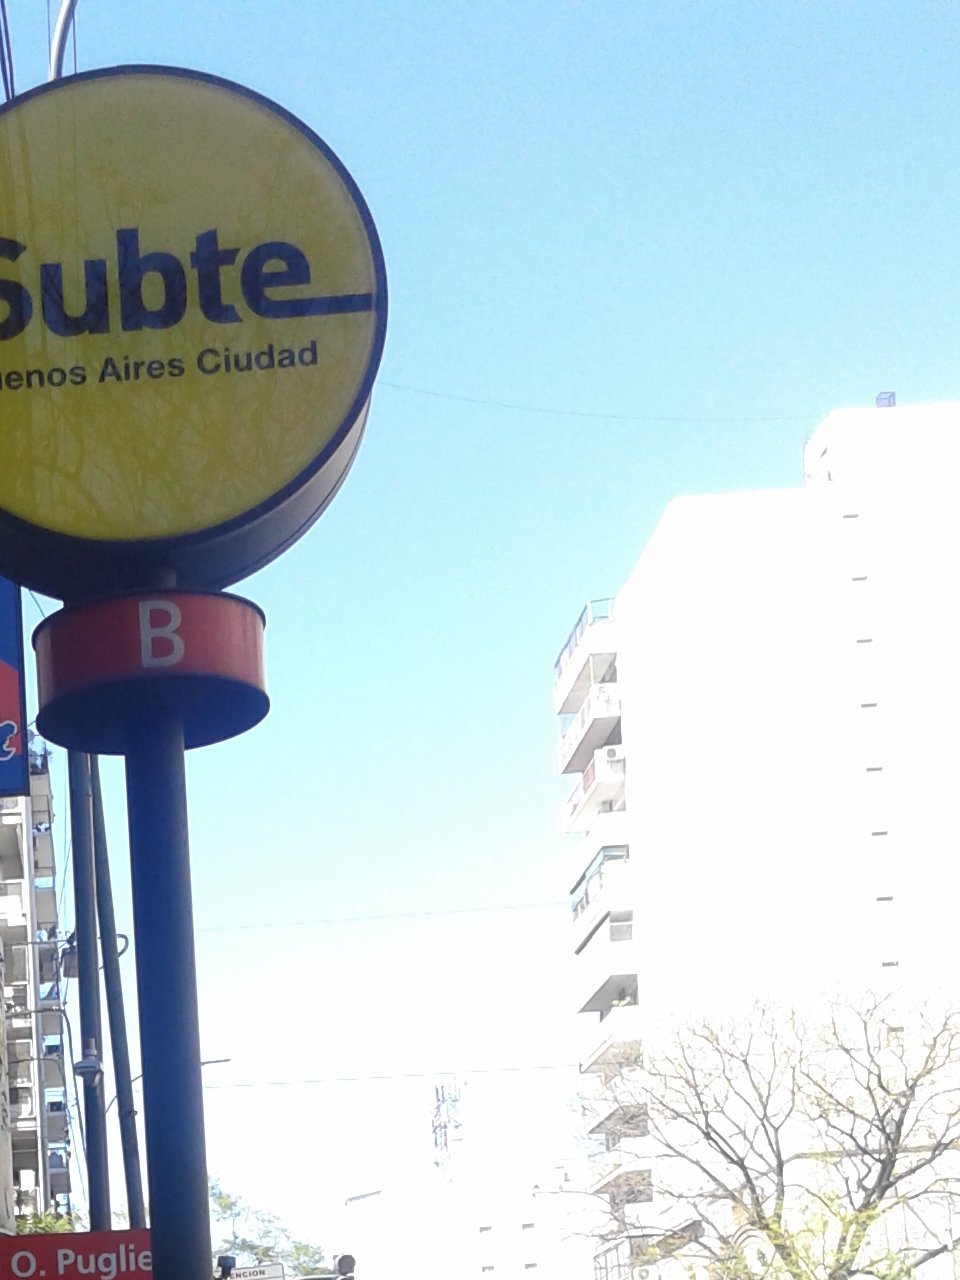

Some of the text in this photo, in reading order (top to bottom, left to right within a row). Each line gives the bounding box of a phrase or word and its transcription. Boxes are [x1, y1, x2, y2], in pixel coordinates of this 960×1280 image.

[98, 358, 185, 384] Aires
[197, 340, 318, 374] Ciudad
[138, 599, 186, 668] B
[10, 1250, 46, 1277] O.
